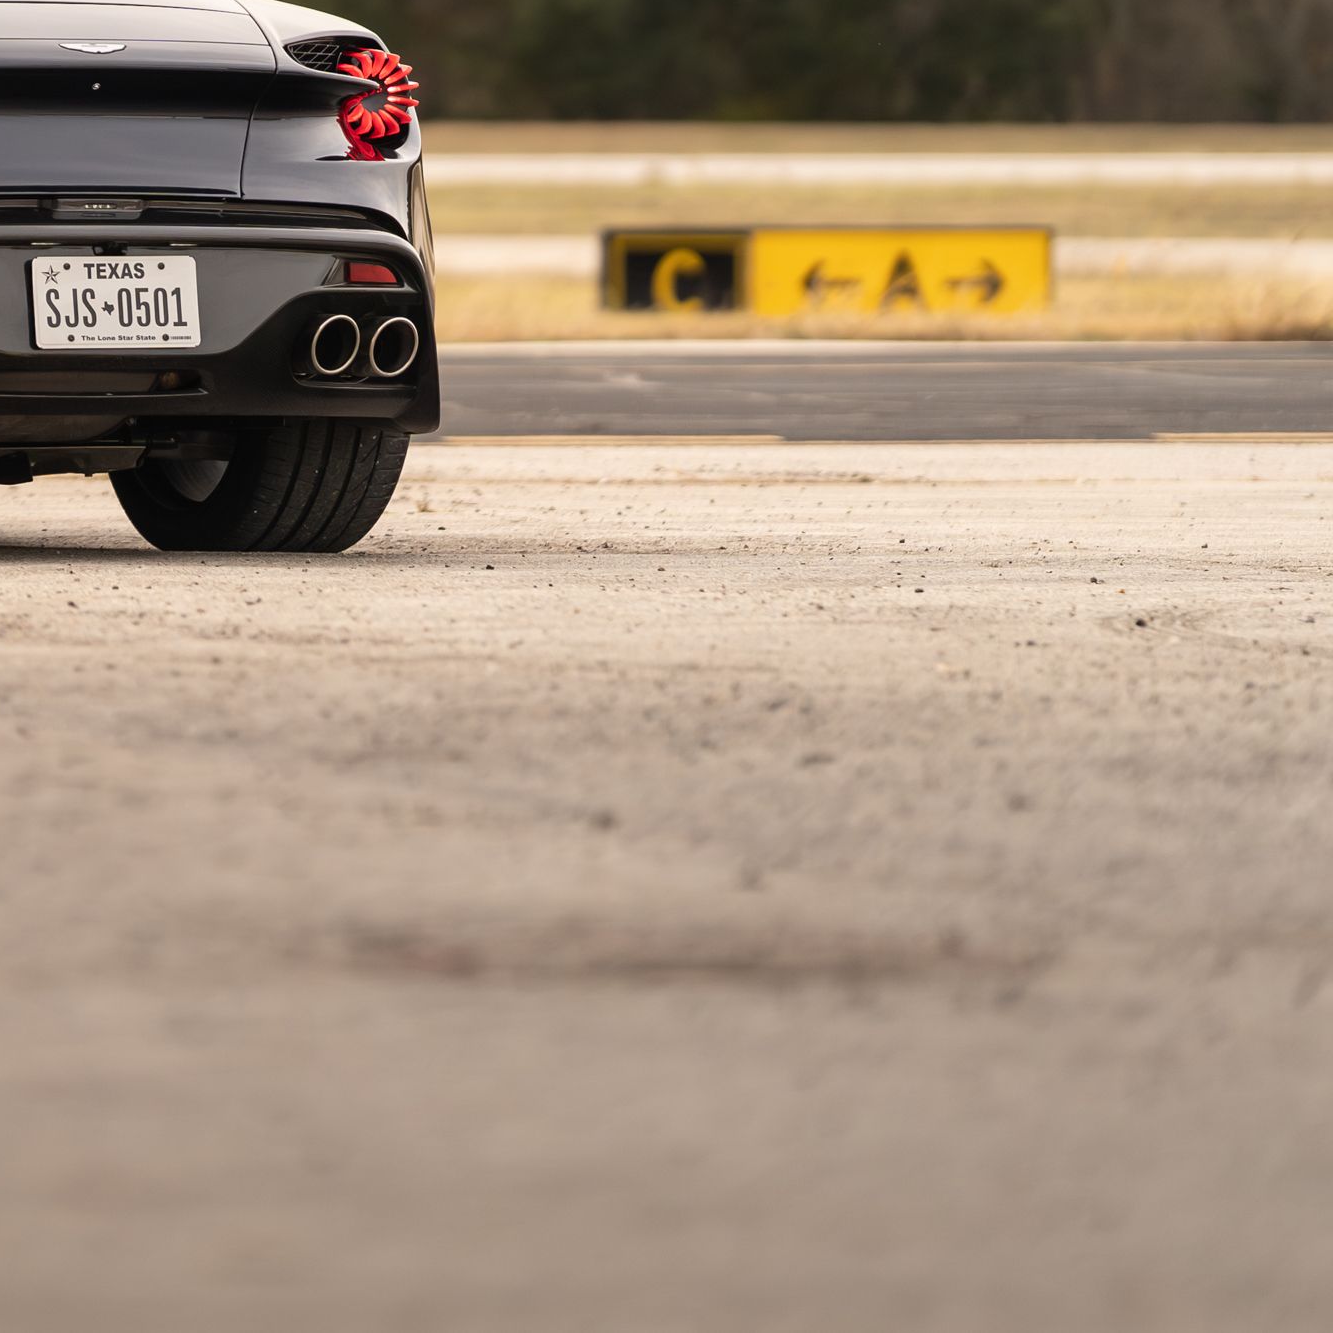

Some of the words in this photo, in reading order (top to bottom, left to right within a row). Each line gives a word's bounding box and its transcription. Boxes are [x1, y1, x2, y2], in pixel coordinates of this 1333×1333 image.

[83, 263, 145, 280] TEXAS
[653, 248, 707, 313] C
[879, 249, 930, 315] A
[45, 288, 97, 328] SJS
[117, 287, 188, 327] 0501
